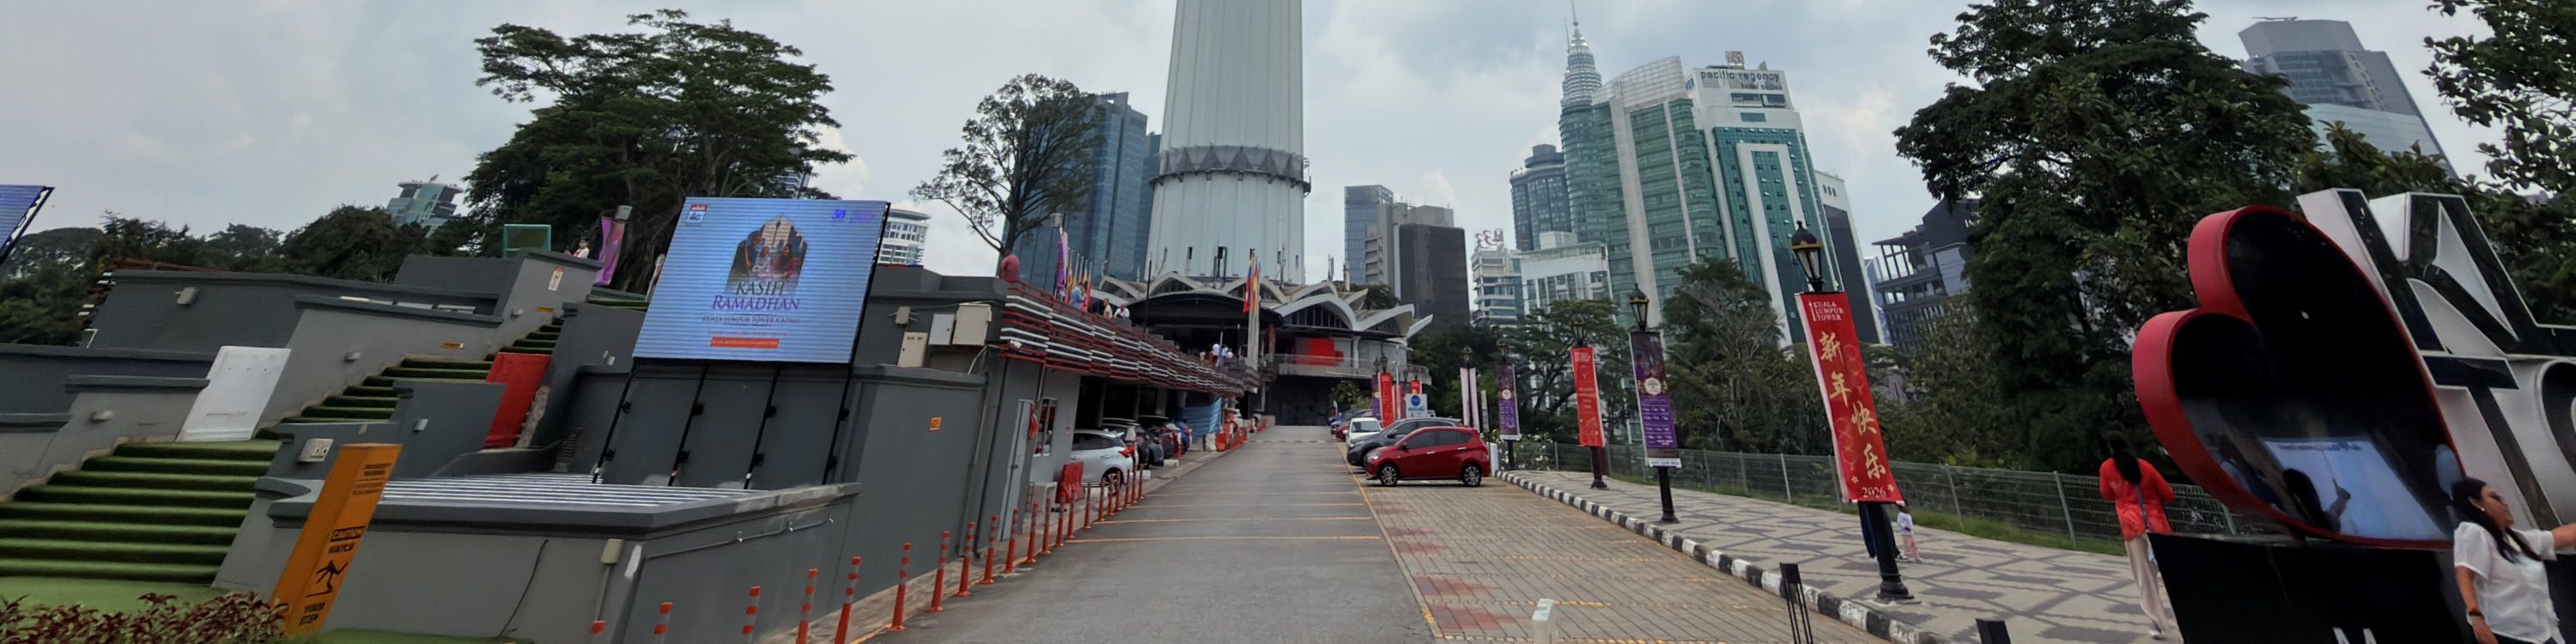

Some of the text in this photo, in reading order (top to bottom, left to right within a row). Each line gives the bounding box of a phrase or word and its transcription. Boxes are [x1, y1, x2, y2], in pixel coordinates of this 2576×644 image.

[1700, 70, 1779, 82] pacific regency
[736, 280, 785, 295] KASIH
[713, 295, 800, 309] RAMADHAN
[1819, 331, 1886, 480] 新年快乐
[1862, 487, 1886, 498] 2026
